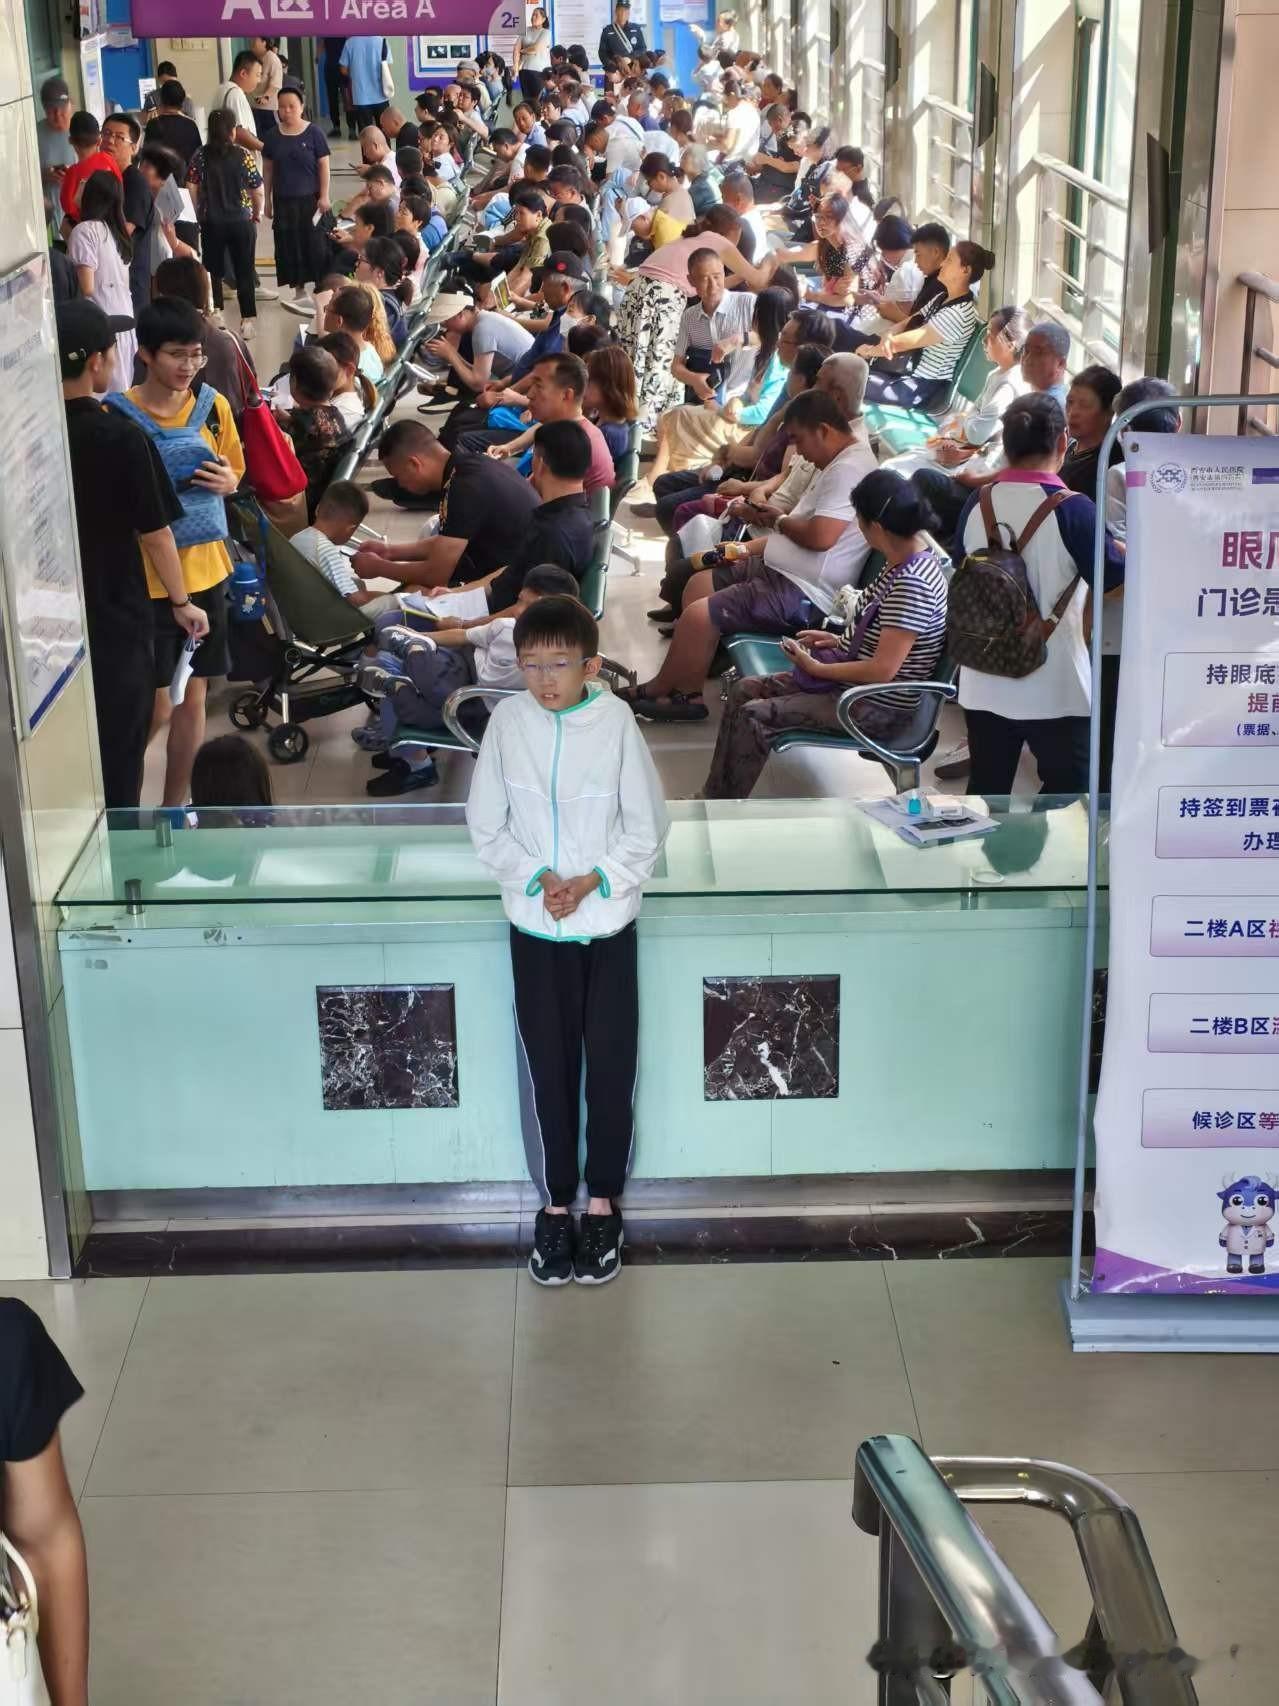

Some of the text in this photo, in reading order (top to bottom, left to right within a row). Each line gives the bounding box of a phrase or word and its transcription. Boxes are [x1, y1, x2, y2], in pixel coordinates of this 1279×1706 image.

[340, 0, 436, 19] Area A
[501, 12, 521, 28] 2F
[1206, 664, 1279, 685] 持眼底
